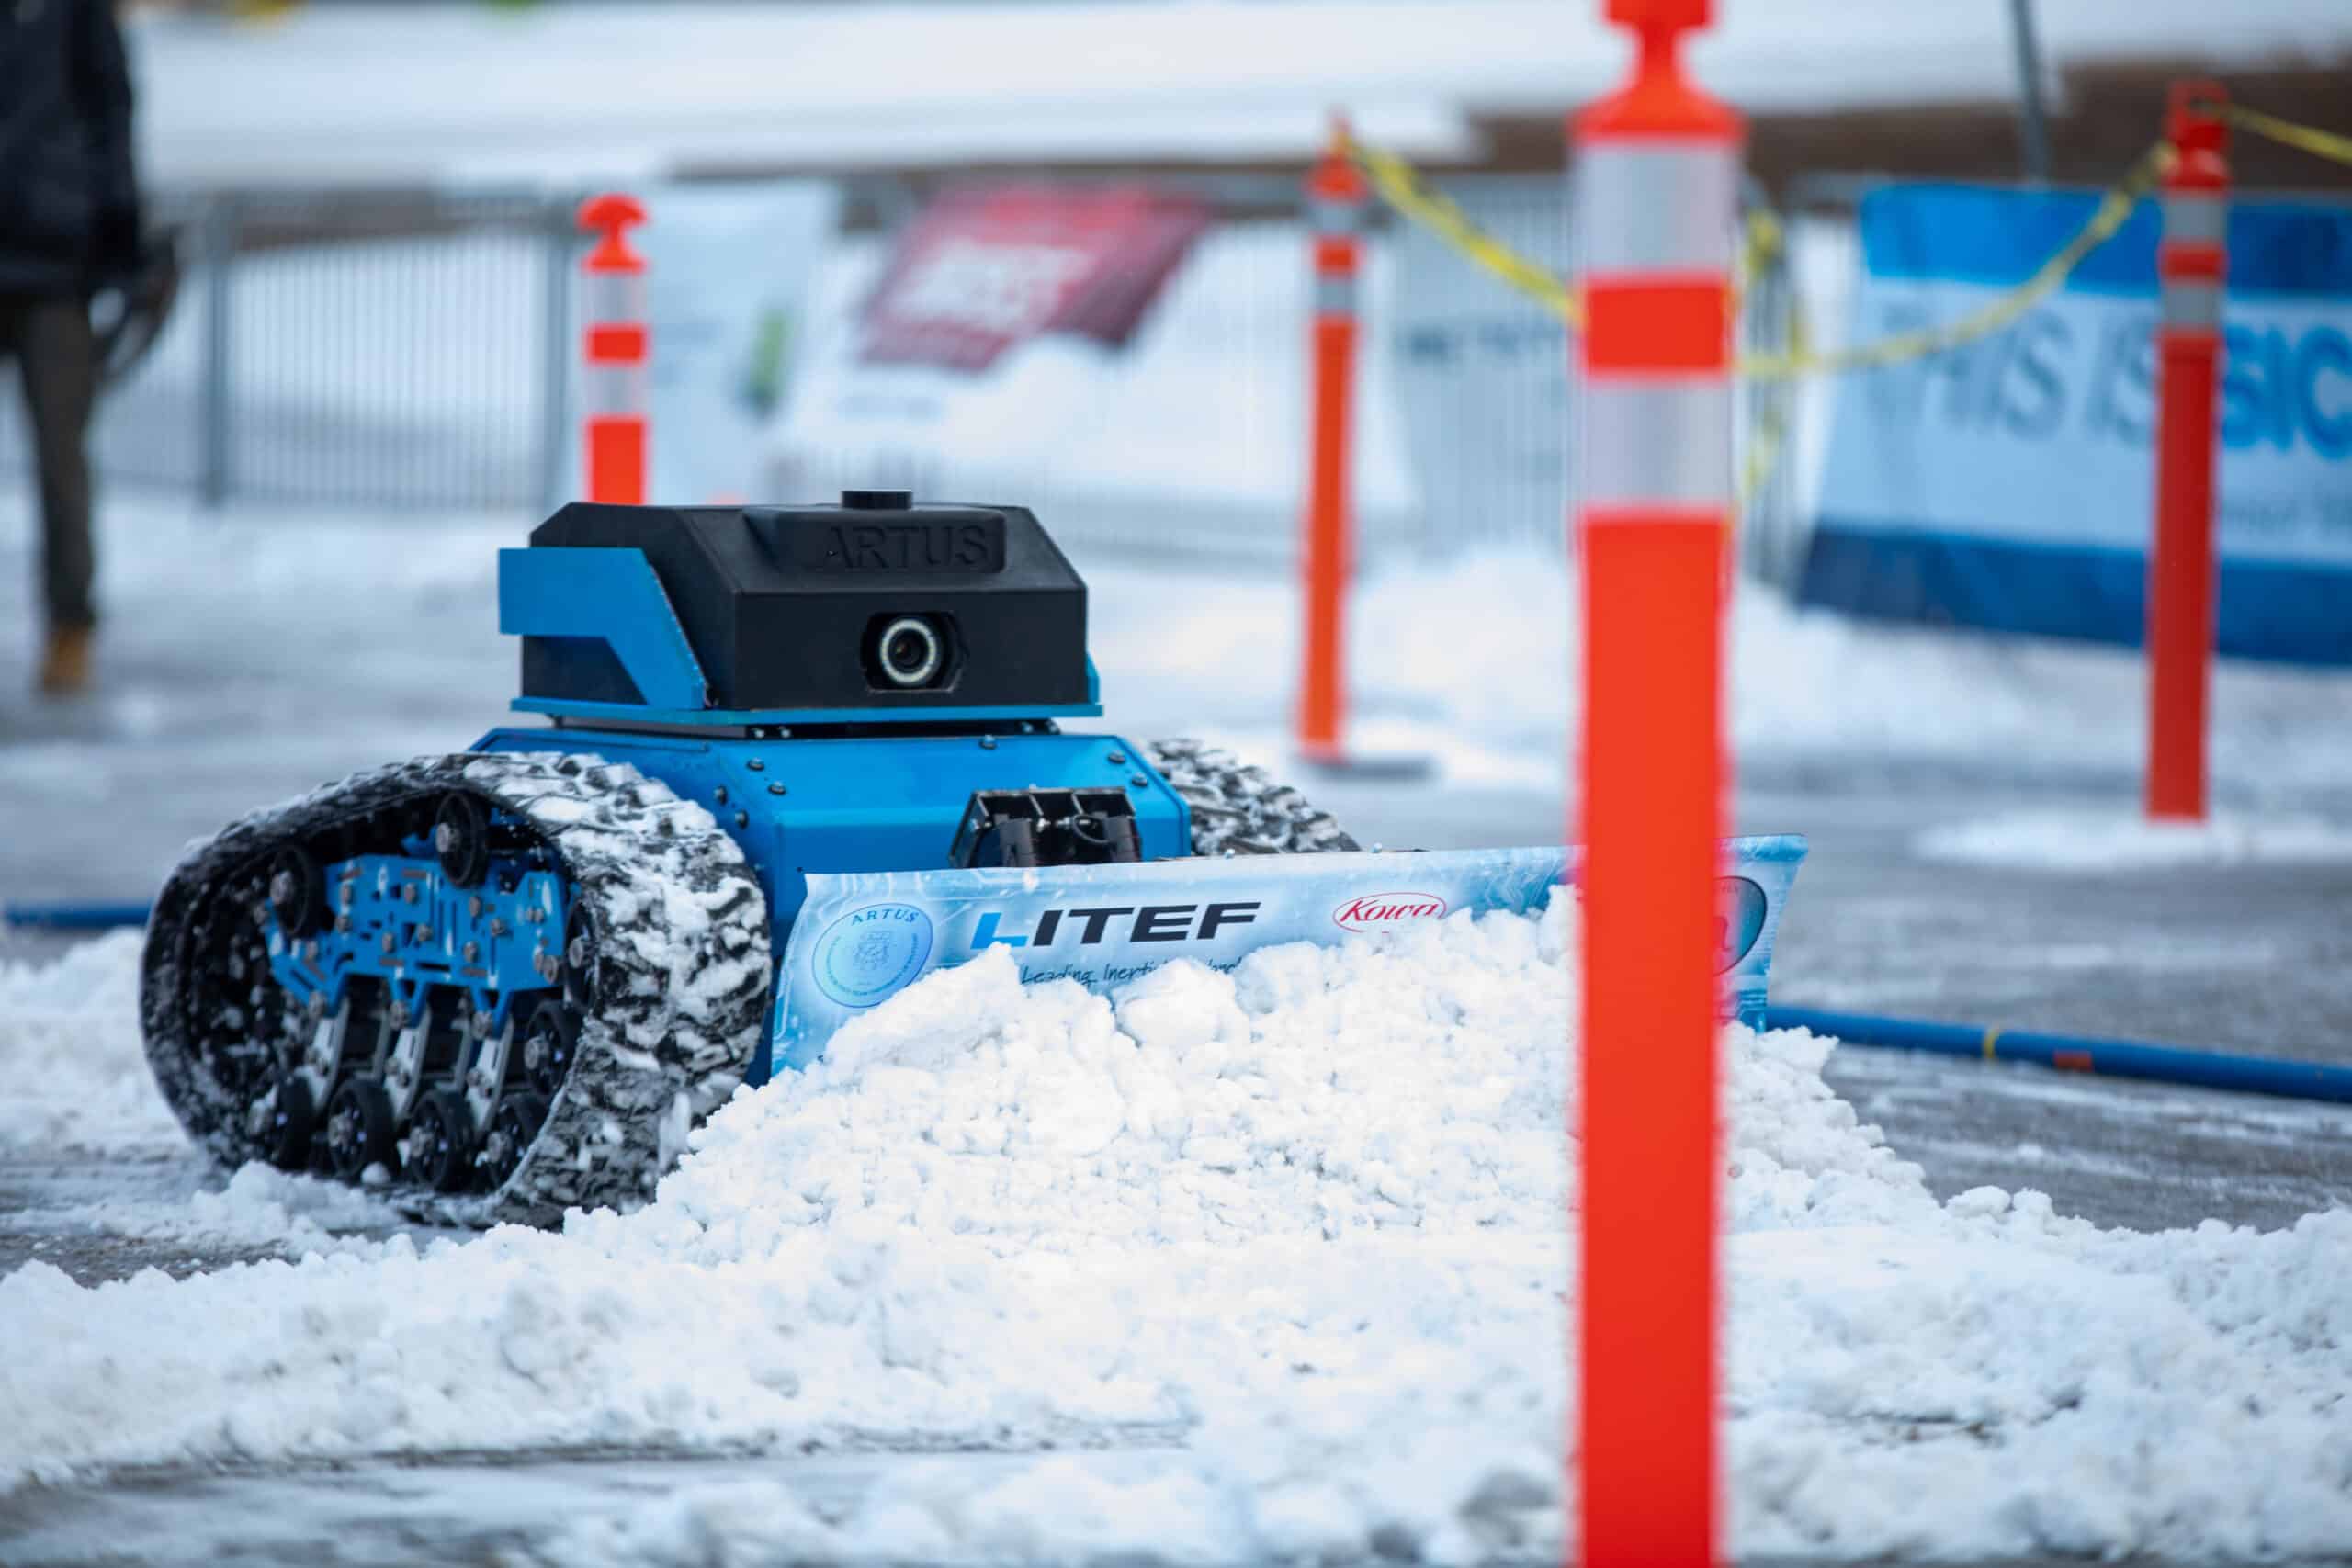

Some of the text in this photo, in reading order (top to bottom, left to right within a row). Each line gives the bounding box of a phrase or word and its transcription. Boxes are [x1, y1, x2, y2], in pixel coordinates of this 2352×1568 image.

[823, 525, 989, 570] ARTUS
[851, 908, 920, 927] ARTUS
[970, 901, 1261, 950] LITEF
[1340, 899, 1439, 922] Kowa
